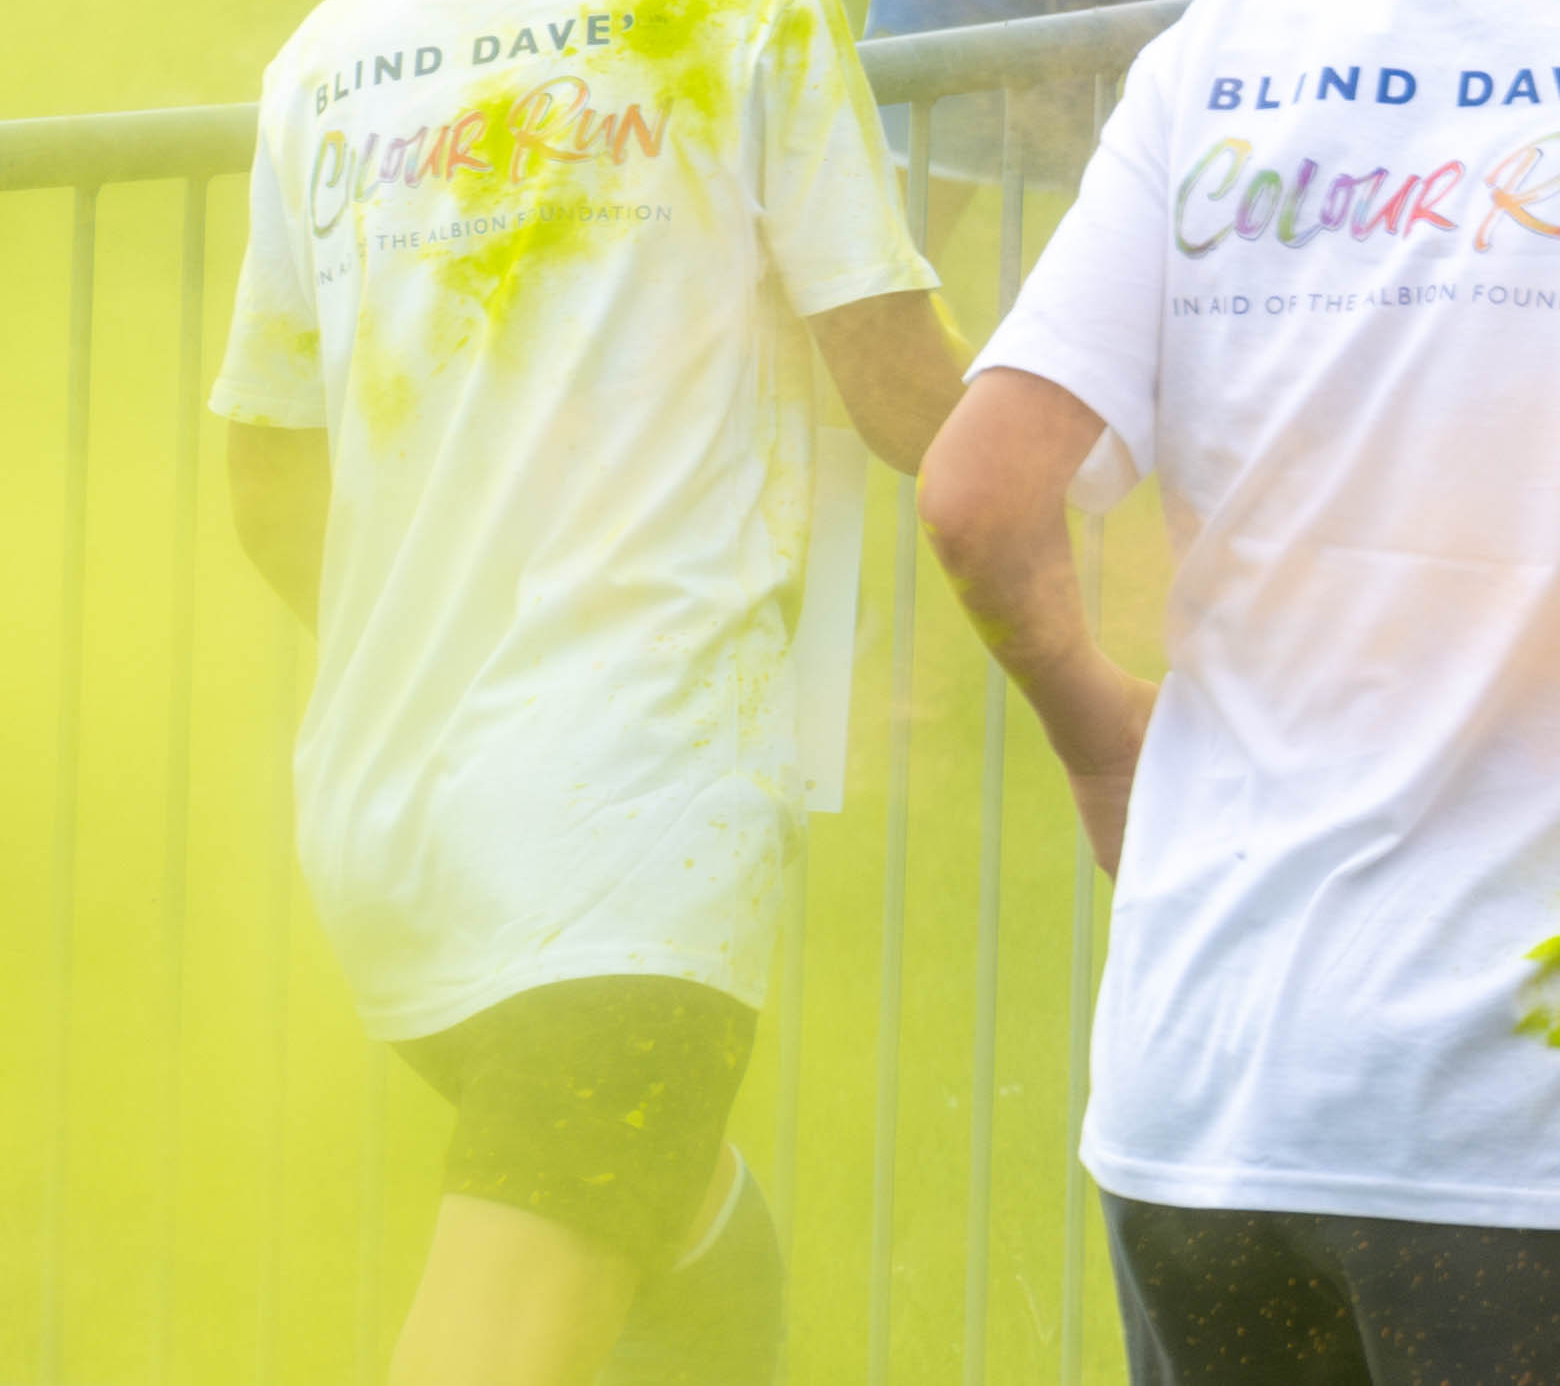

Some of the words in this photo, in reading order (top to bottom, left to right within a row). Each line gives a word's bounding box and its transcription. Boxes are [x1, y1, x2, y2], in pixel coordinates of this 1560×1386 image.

[314, 45, 444, 118] BLIND
[1207, 65, 1418, 111] BLIND
[374, 231, 422, 253] THE
[427, 215, 507, 244] ALBION
[517, 204, 674, 228] FUNDATION
[1172, 297, 1201, 316] IN
[1208, 295, 1251, 316] AID
[1264, 295, 1298, 316] OF
[1307, 293, 1358, 313] THE
[1365, 283, 1458, 308] ALBION
